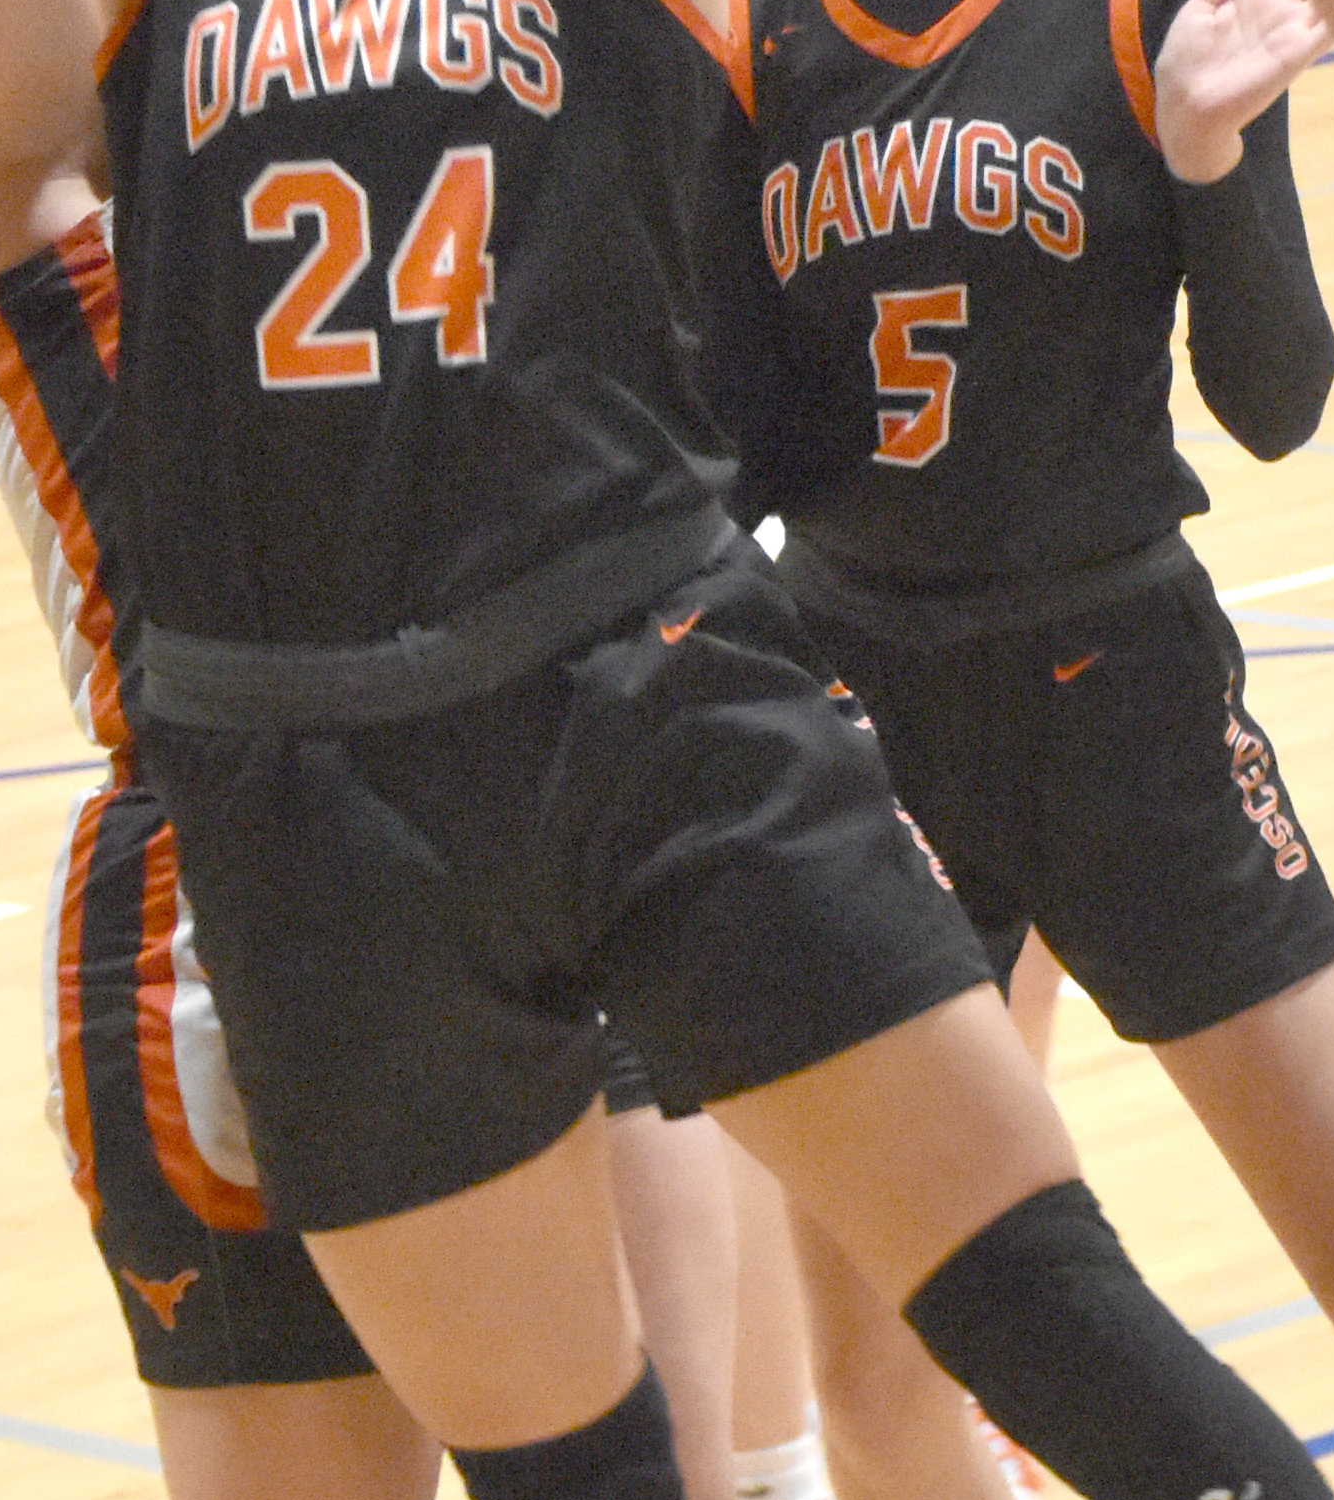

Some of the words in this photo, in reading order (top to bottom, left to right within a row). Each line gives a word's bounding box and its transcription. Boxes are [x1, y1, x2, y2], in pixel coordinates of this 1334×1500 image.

[242, 144, 496, 391] 24
[761, 116, 1086, 290] DAWGS
[869, 283, 968, 469] 5
